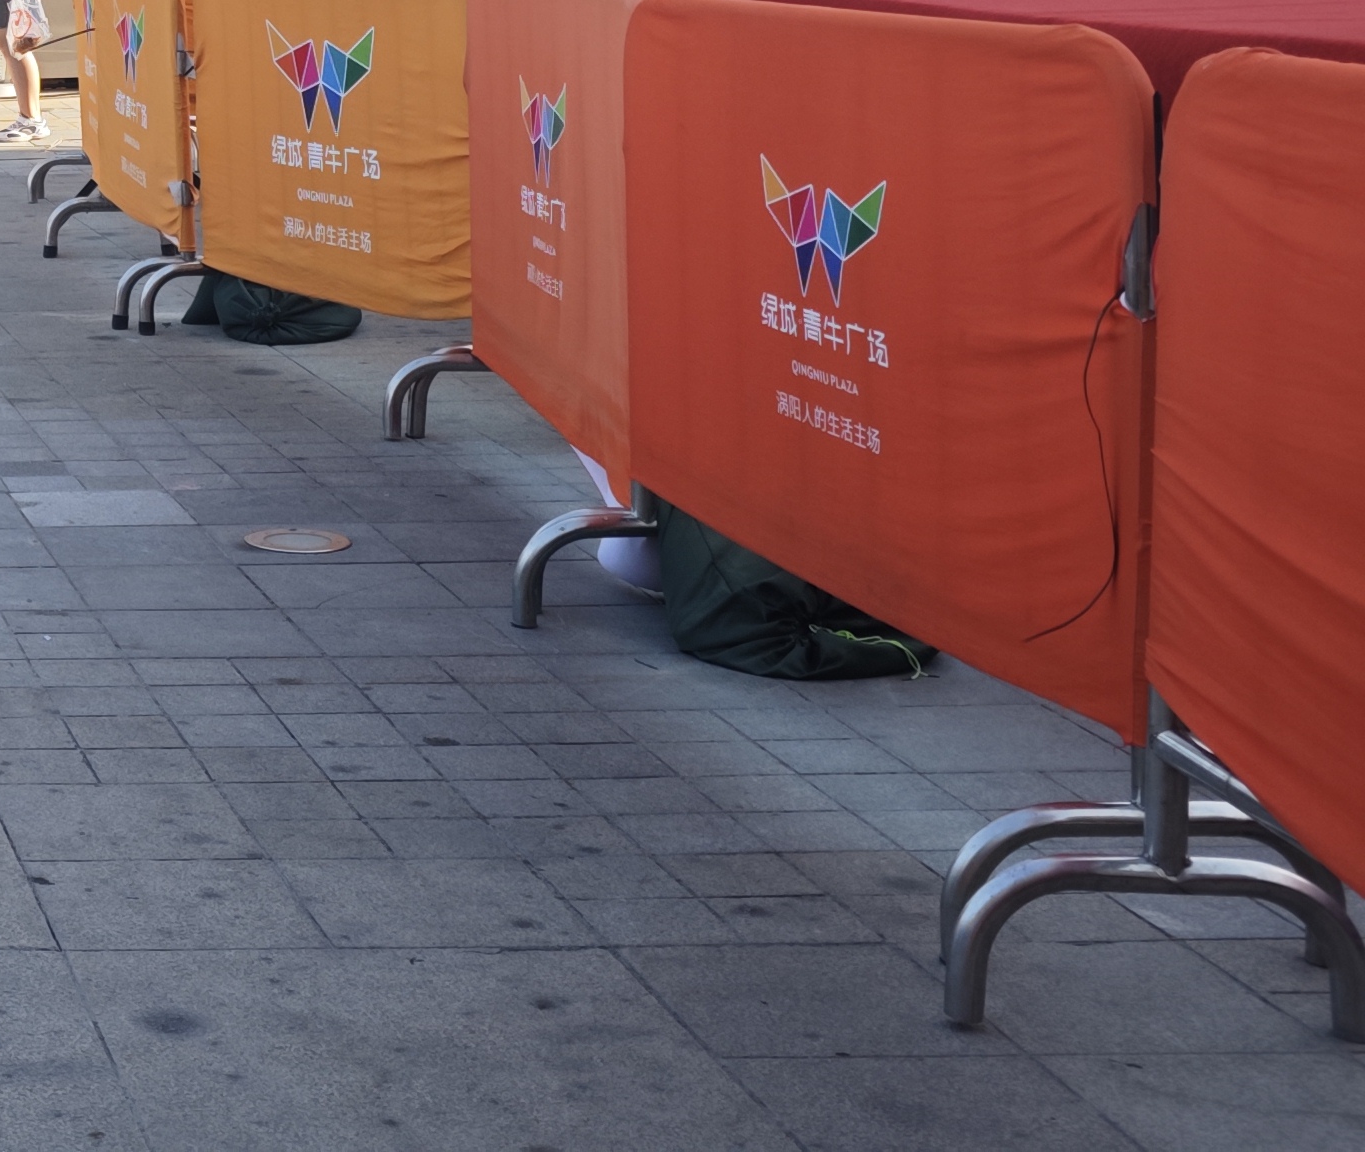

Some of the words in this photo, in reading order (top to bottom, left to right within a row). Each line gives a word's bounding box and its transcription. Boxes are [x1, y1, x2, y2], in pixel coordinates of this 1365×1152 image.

[297, 187, 329, 204] QINGNIU
[329, 193, 354, 208] PLAZA
[283, 216, 372, 254] 涡阳人的生活主场
[791, 359, 829, 385] QINGNIU
[830, 374, 859, 397] PLAZA
[775, 389, 881, 455] 涡阳人的生活主场
